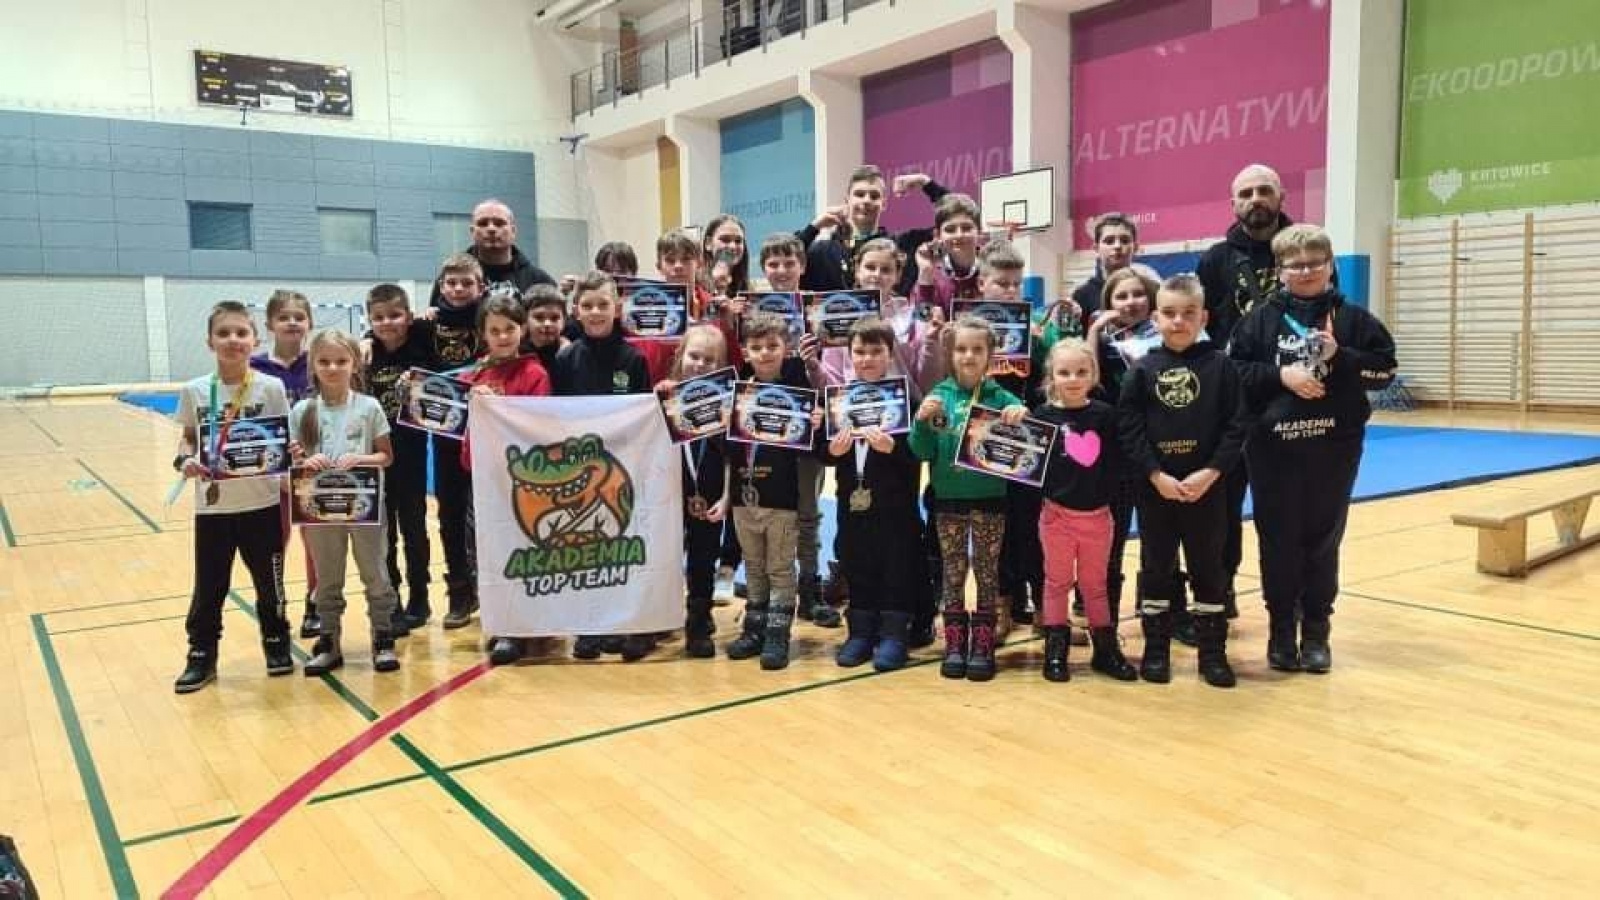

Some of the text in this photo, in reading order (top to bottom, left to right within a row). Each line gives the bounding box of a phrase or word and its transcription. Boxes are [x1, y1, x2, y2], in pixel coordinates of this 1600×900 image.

[504, 535, 646, 577] AKADEMIA
[525, 564, 628, 597] TOP TEAM
